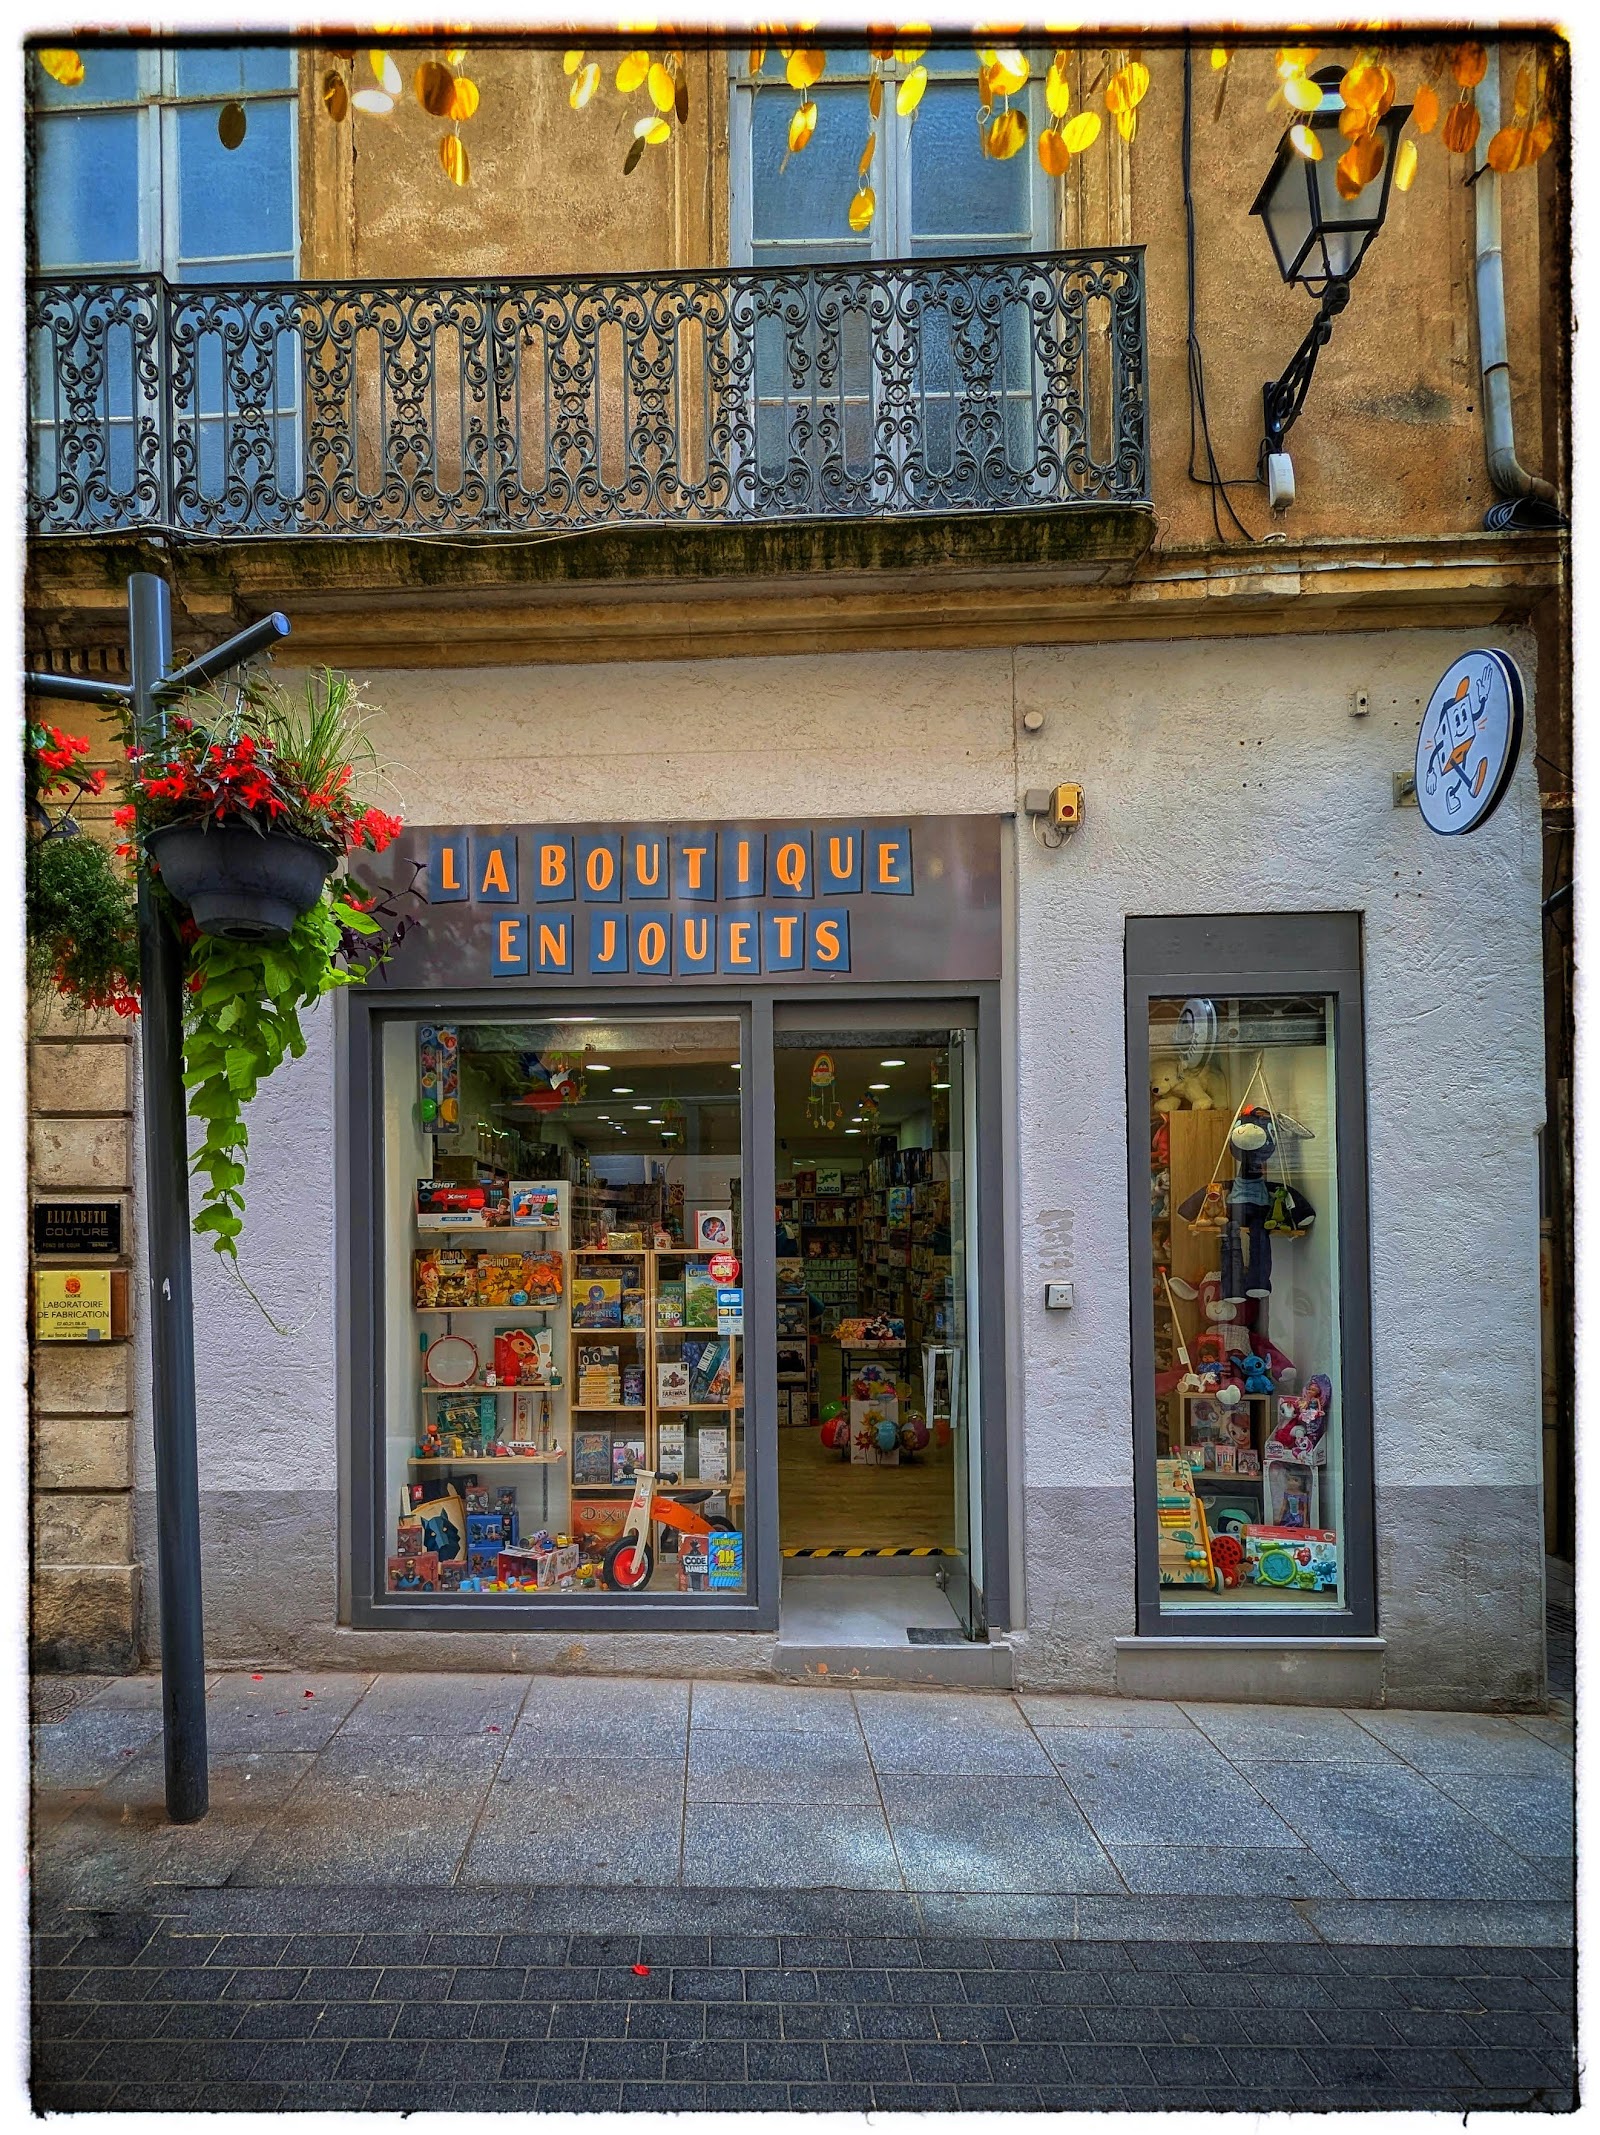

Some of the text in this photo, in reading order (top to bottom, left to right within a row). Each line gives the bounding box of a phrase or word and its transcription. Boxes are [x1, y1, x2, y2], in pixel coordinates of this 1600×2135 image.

[443, 837, 900, 892] LA BOUTIQUE
[500, 917, 839, 965] EN JOUETS
[47, 1210, 107, 1224] ELIZABETH
[45, 1228, 109, 1236] COUTURE
[43, 1300, 103, 1308] LABORATOIRE
[660, 1312, 681, 1320] TRIO
[684, 1556, 707, 1565] CODE
[684, 1565, 708, 1574] NAMES
